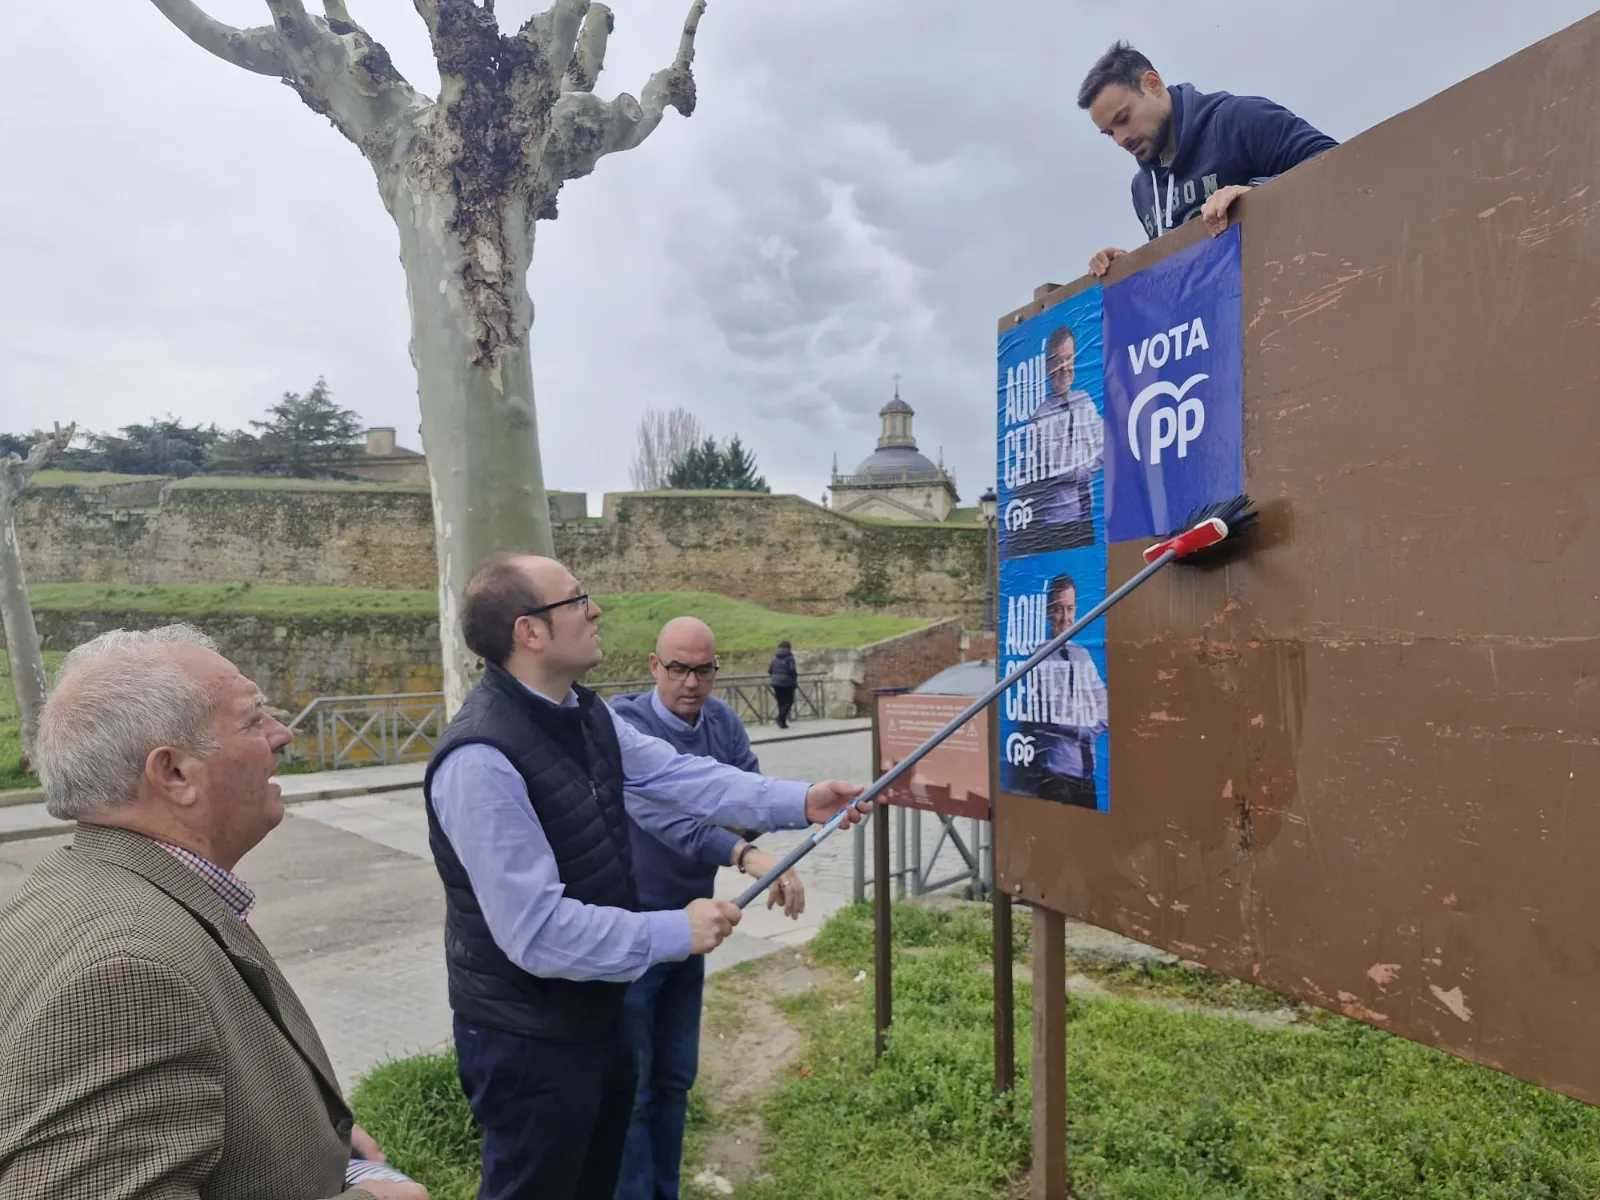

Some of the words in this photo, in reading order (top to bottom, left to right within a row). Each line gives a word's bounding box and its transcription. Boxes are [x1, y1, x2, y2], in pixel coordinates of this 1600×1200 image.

[1005, 338, 1047, 427] AQUÍ
[1127, 317, 1210, 376] VOTA
[1004, 407, 1099, 490] CERTEZAS
[1005, 580, 1049, 657] AQUÍ
